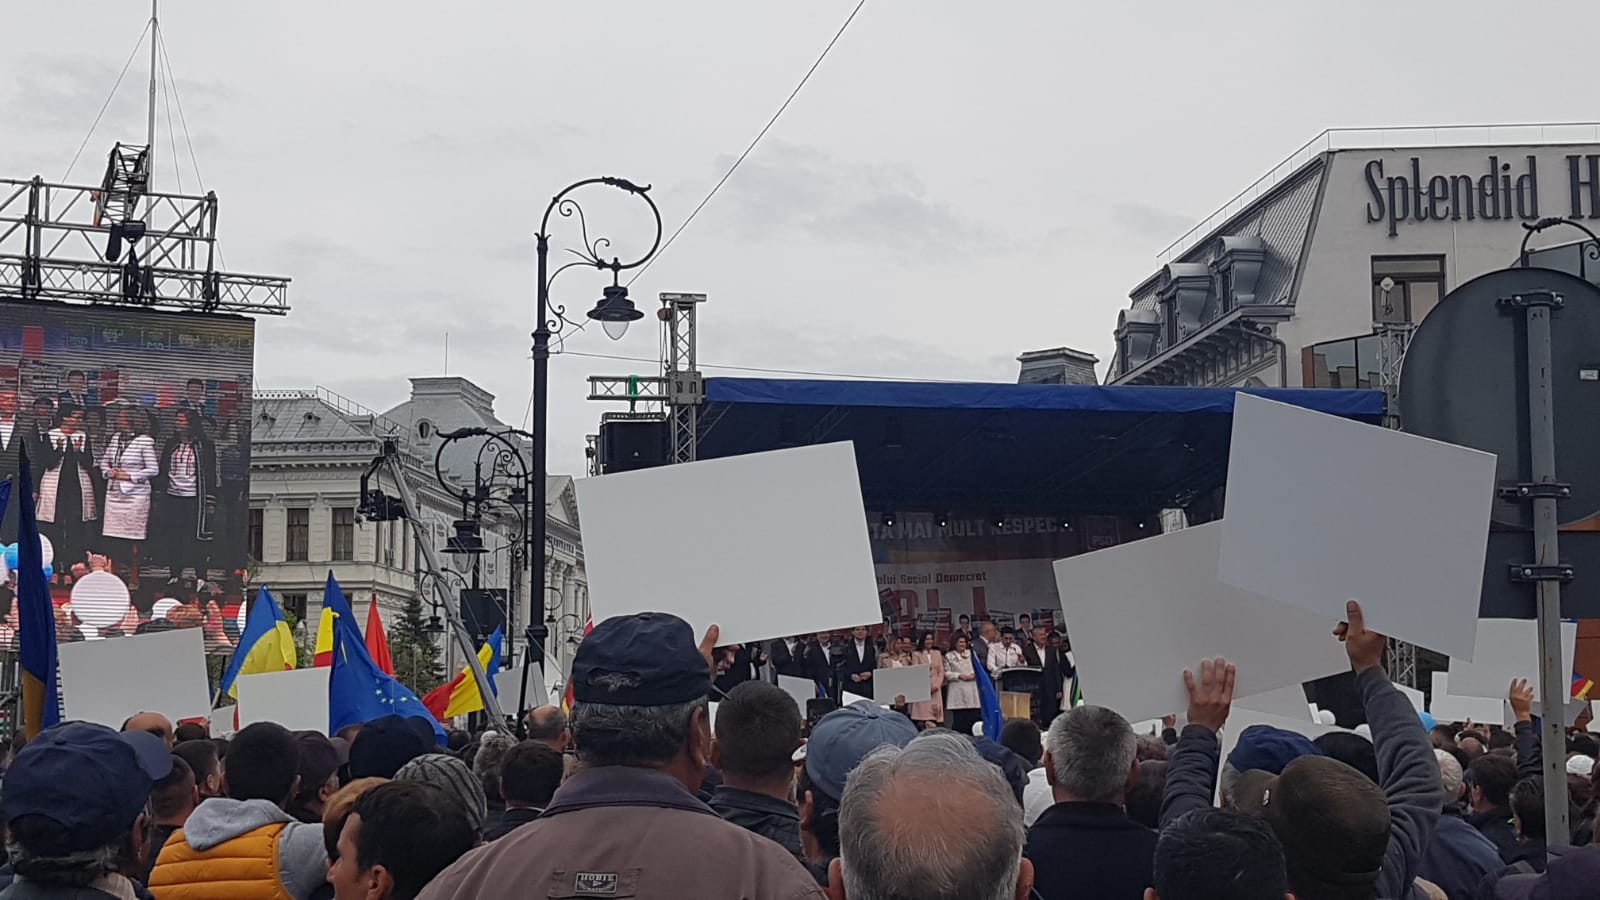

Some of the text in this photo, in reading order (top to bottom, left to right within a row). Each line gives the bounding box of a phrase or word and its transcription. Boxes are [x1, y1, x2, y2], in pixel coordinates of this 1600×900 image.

[1365, 156, 1539, 237] Splendid
[897, 521, 932, 538] MAI
[991, 517, 1073, 536] RESPEC
[900, 573, 931, 584] Social
[936, 572, 986, 583] Democrat
